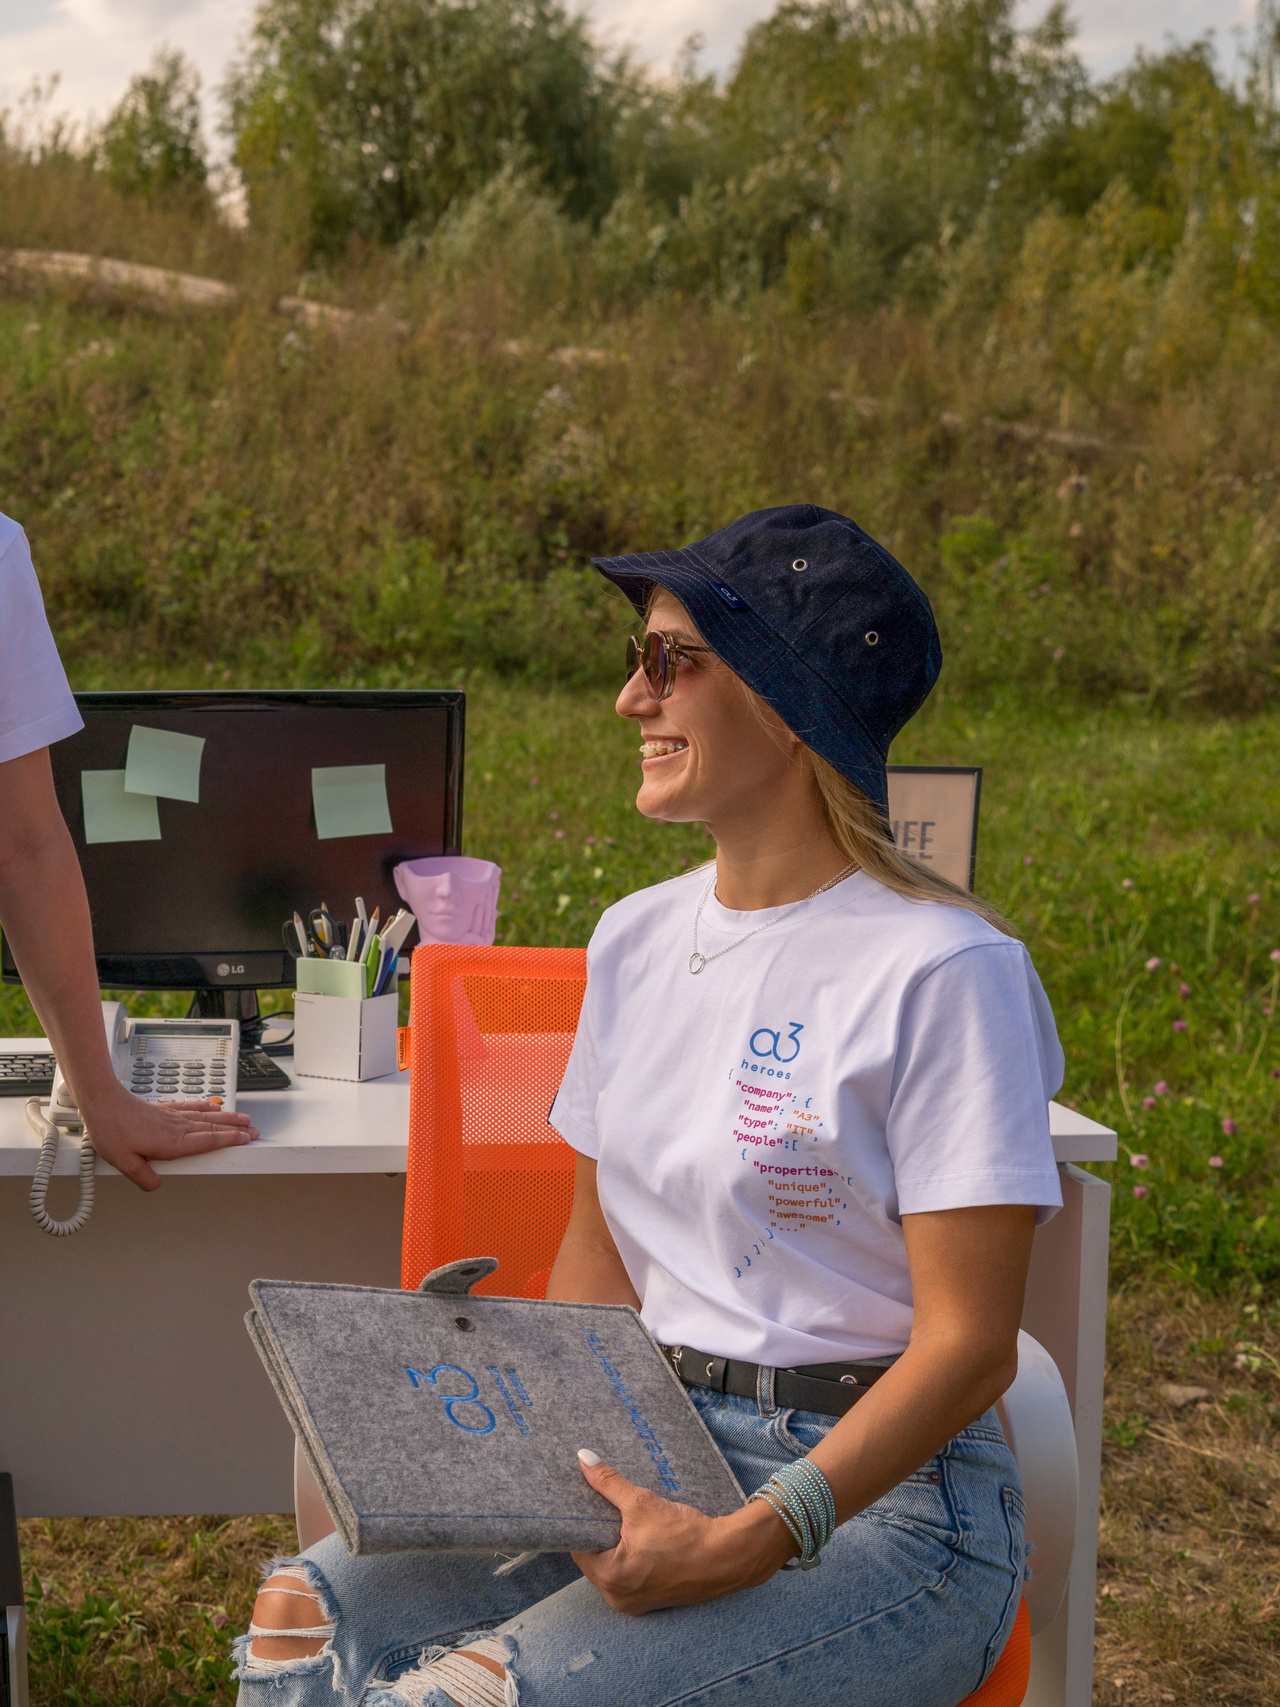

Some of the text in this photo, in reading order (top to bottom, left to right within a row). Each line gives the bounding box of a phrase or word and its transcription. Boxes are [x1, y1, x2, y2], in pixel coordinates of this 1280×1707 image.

[231, 965, 245, 974] LG
[749, 1021, 805, 1063] a3
[740, 1059, 791, 1080] heroes
